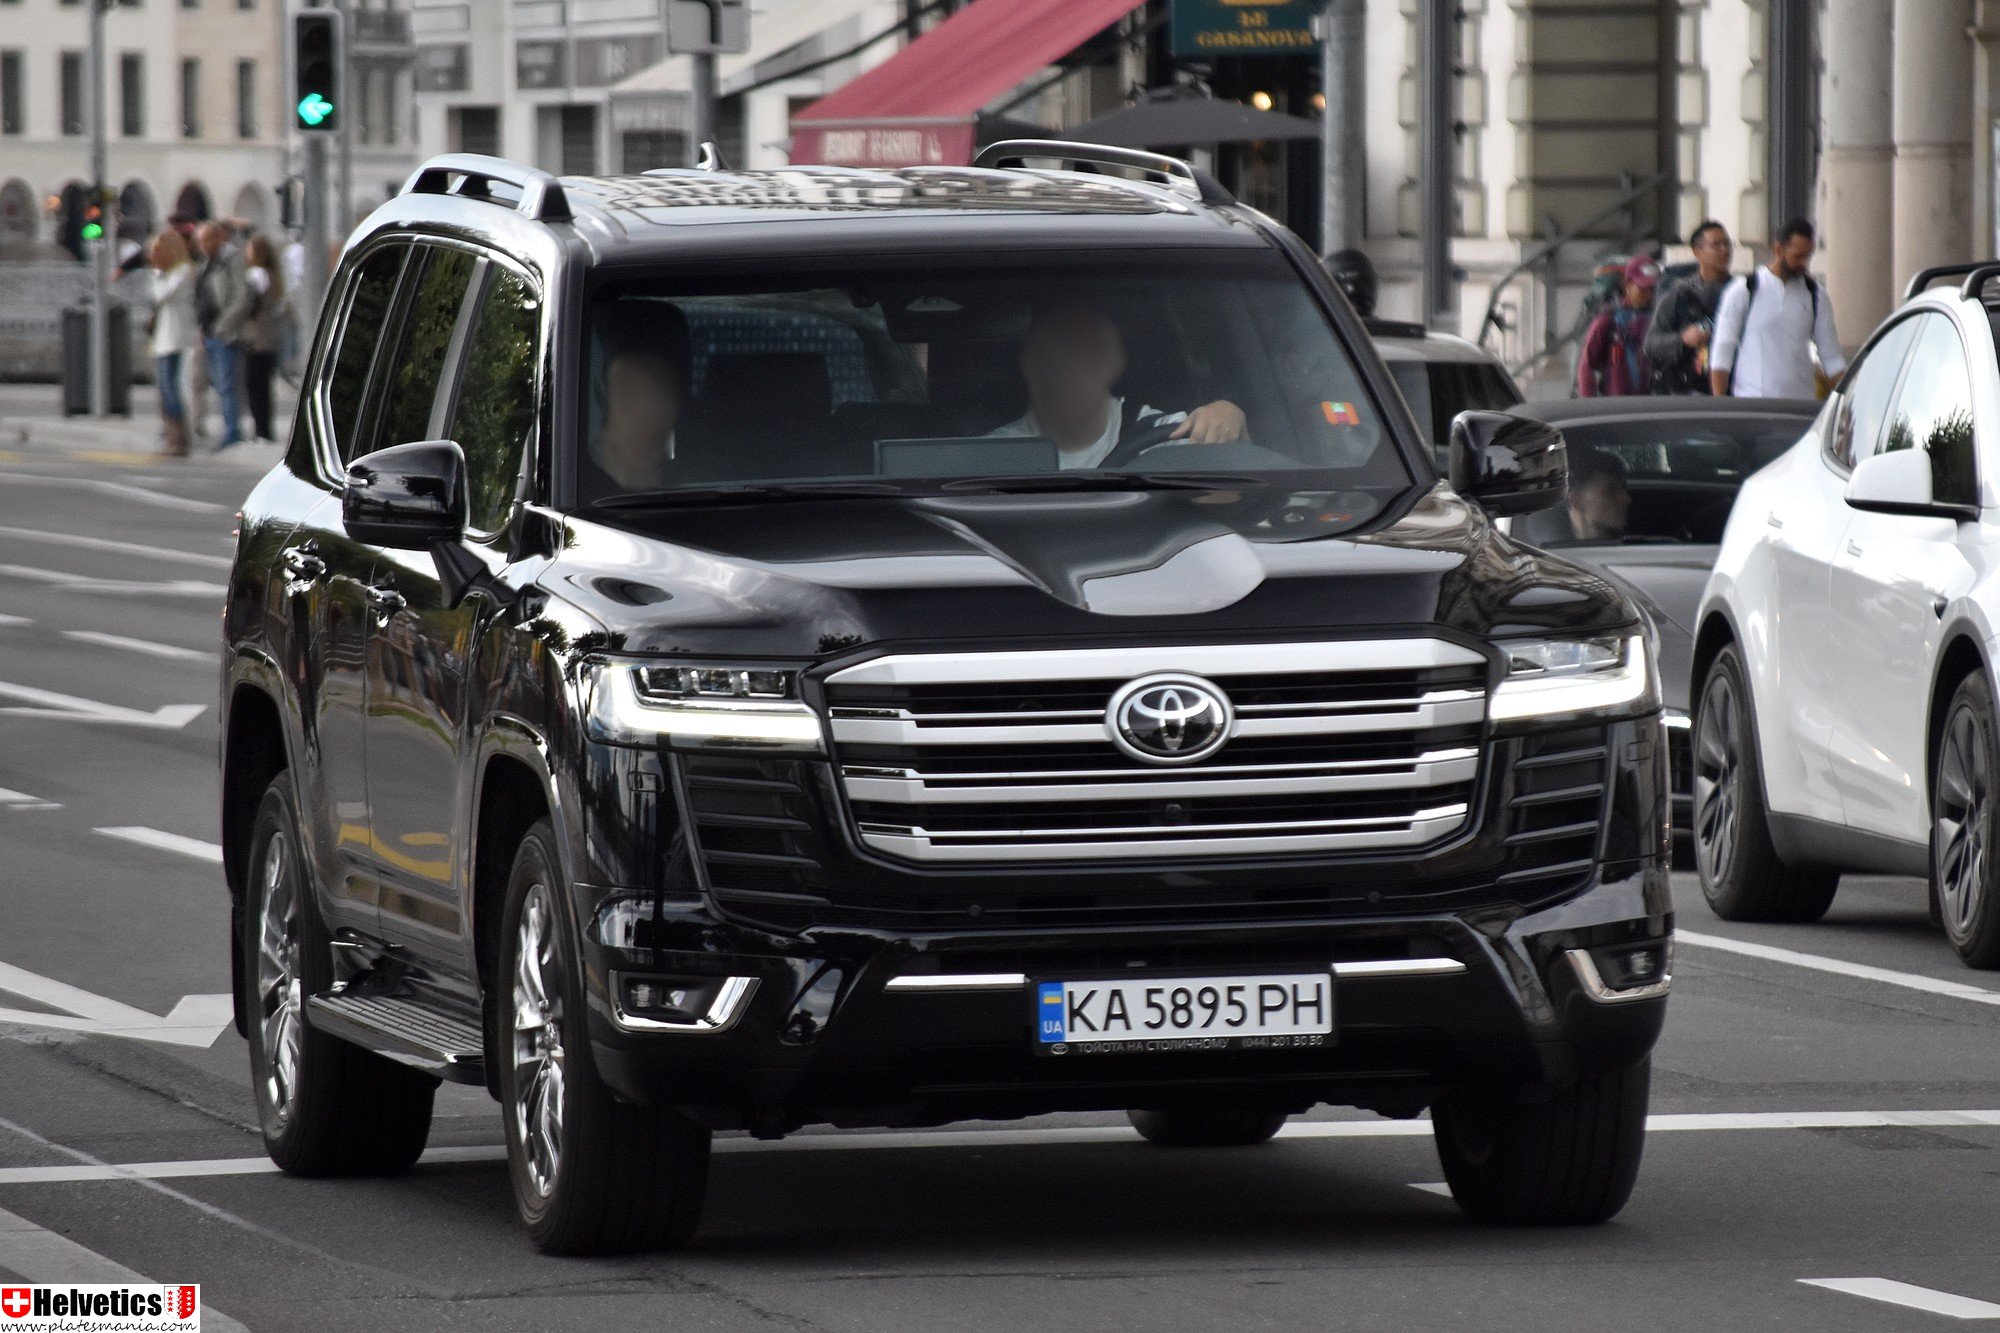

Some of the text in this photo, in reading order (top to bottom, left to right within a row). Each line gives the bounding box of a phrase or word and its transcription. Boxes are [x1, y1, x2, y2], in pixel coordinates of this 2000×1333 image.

[1068, 982, 1323, 1032] KA 5895 PH
[1043, 1020, 1062, 1034] UA
[1077, 1041, 1124, 1053] ТОЙОТА
[1127, 1040, 1143, 1051] НА
[1242, 1037, 1269, 1049] (044)
[1272, 1036, 1290, 1047] 201
